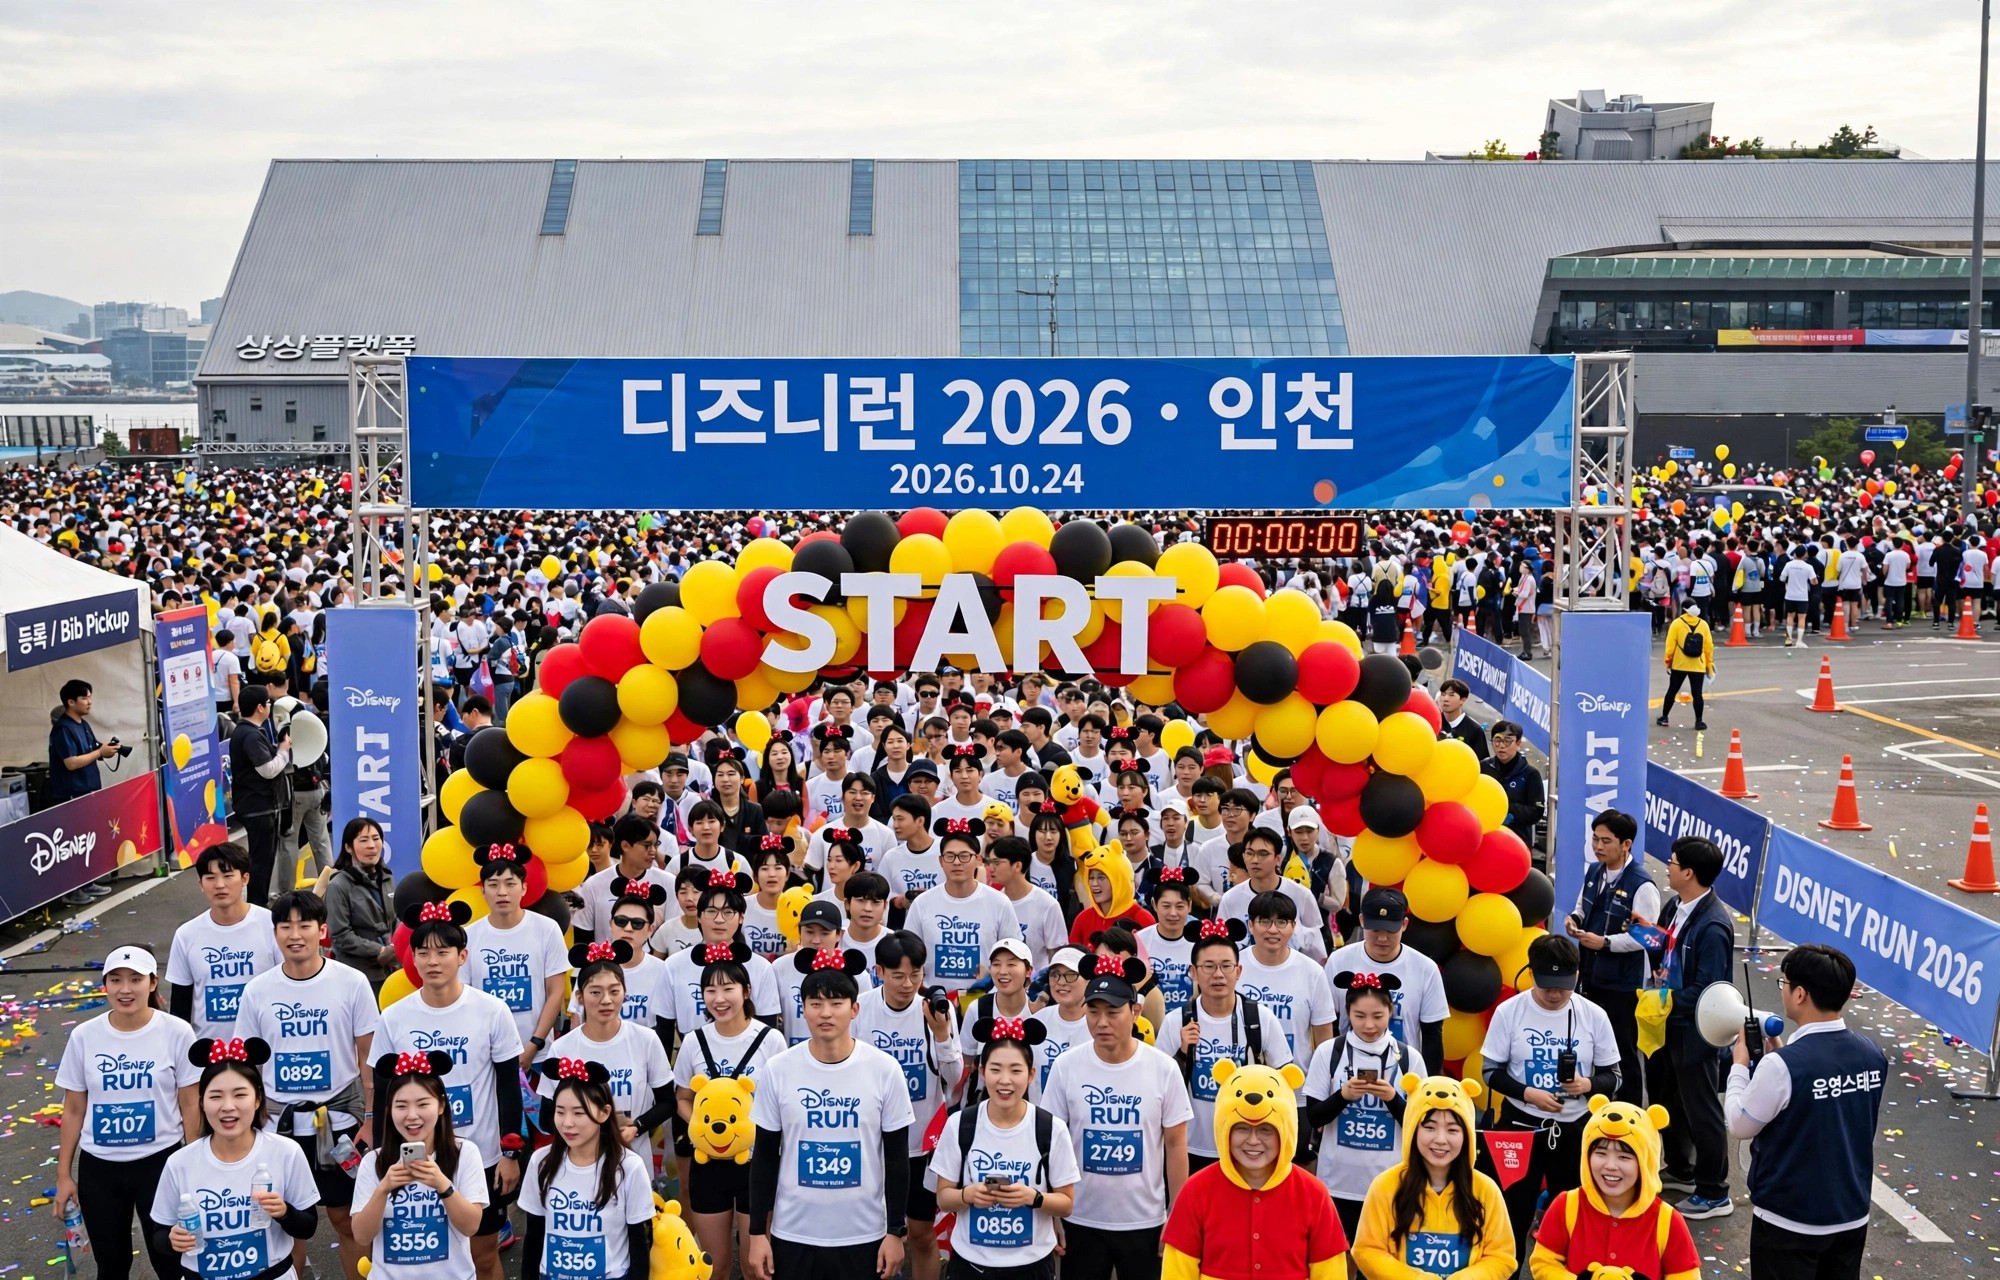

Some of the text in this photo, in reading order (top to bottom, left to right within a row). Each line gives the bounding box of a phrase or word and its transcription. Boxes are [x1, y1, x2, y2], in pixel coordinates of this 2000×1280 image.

[236, 334, 416, 360] 상상플랫폼
[622, 373, 916, 452] 디즈니런
[942, 378, 1132, 446] 2026
[1208, 372, 1354, 451] 인천
[890, 463, 1085, 495] 2026.10.24
[1211, 521, 1359, 556] 00:00:00
[18, 621, 47, 655] 등록
[60, 617, 83, 642] Bib
[86, 610, 130, 636] Pickup
[760, 571, 1177, 677] START
[1645, 790, 1680, 837] SNEY
[1774, 864, 1984, 1005] DISNEY RUN 2026
[211, 997, 241, 1011] 134
[620, 1004, 647, 1019] UN
[280, 1064, 323, 1082] 0892
[1812, 1070, 1881, 1099] 운영스태프
[100, 1115, 147, 1134] 2107
[1344, 1120, 1387, 1140] 3556
[1090, 1144, 1136, 1162] 2749
[806, 1156, 852, 1175] 1349
[196, 1188, 251, 1212] Disne
[976, 1215, 1025, 1235] 0856
[390, 1231, 440, 1251] 3556
[206, 1247, 258, 1272] 2709
[552, 1250, 597, 1271] 3356
[1412, 1247, 1460, 1268] 3701
